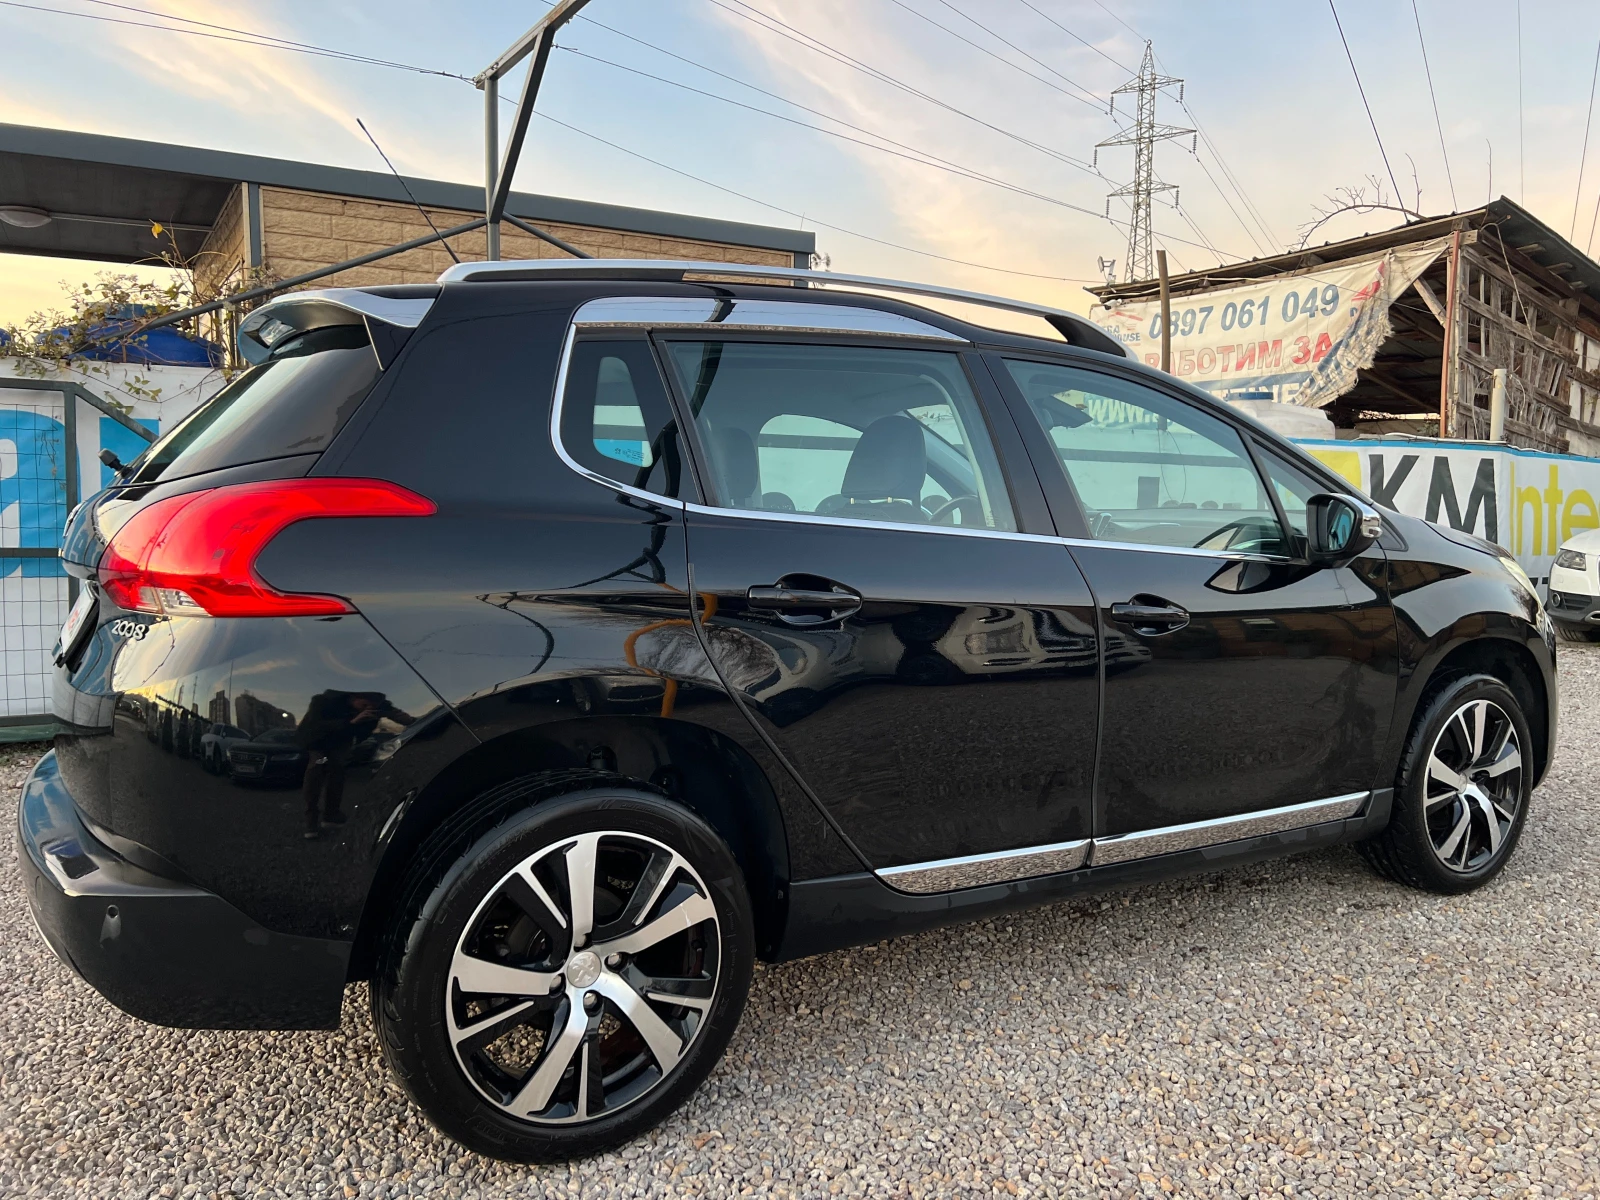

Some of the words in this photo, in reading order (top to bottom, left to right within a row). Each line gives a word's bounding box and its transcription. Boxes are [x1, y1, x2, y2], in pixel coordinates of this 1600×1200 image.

[1149, 305, 1214, 339] 0897
[1220, 296, 1270, 331] 061
[1282, 284, 1340, 322] 049
[1114, 332, 1141, 342] OUSE
[1291, 332, 1334, 364] ЗА
[1368, 454, 1498, 544] KM
[1510, 461, 1600, 556] Inte
[111, 619, 147, 640] 2008
